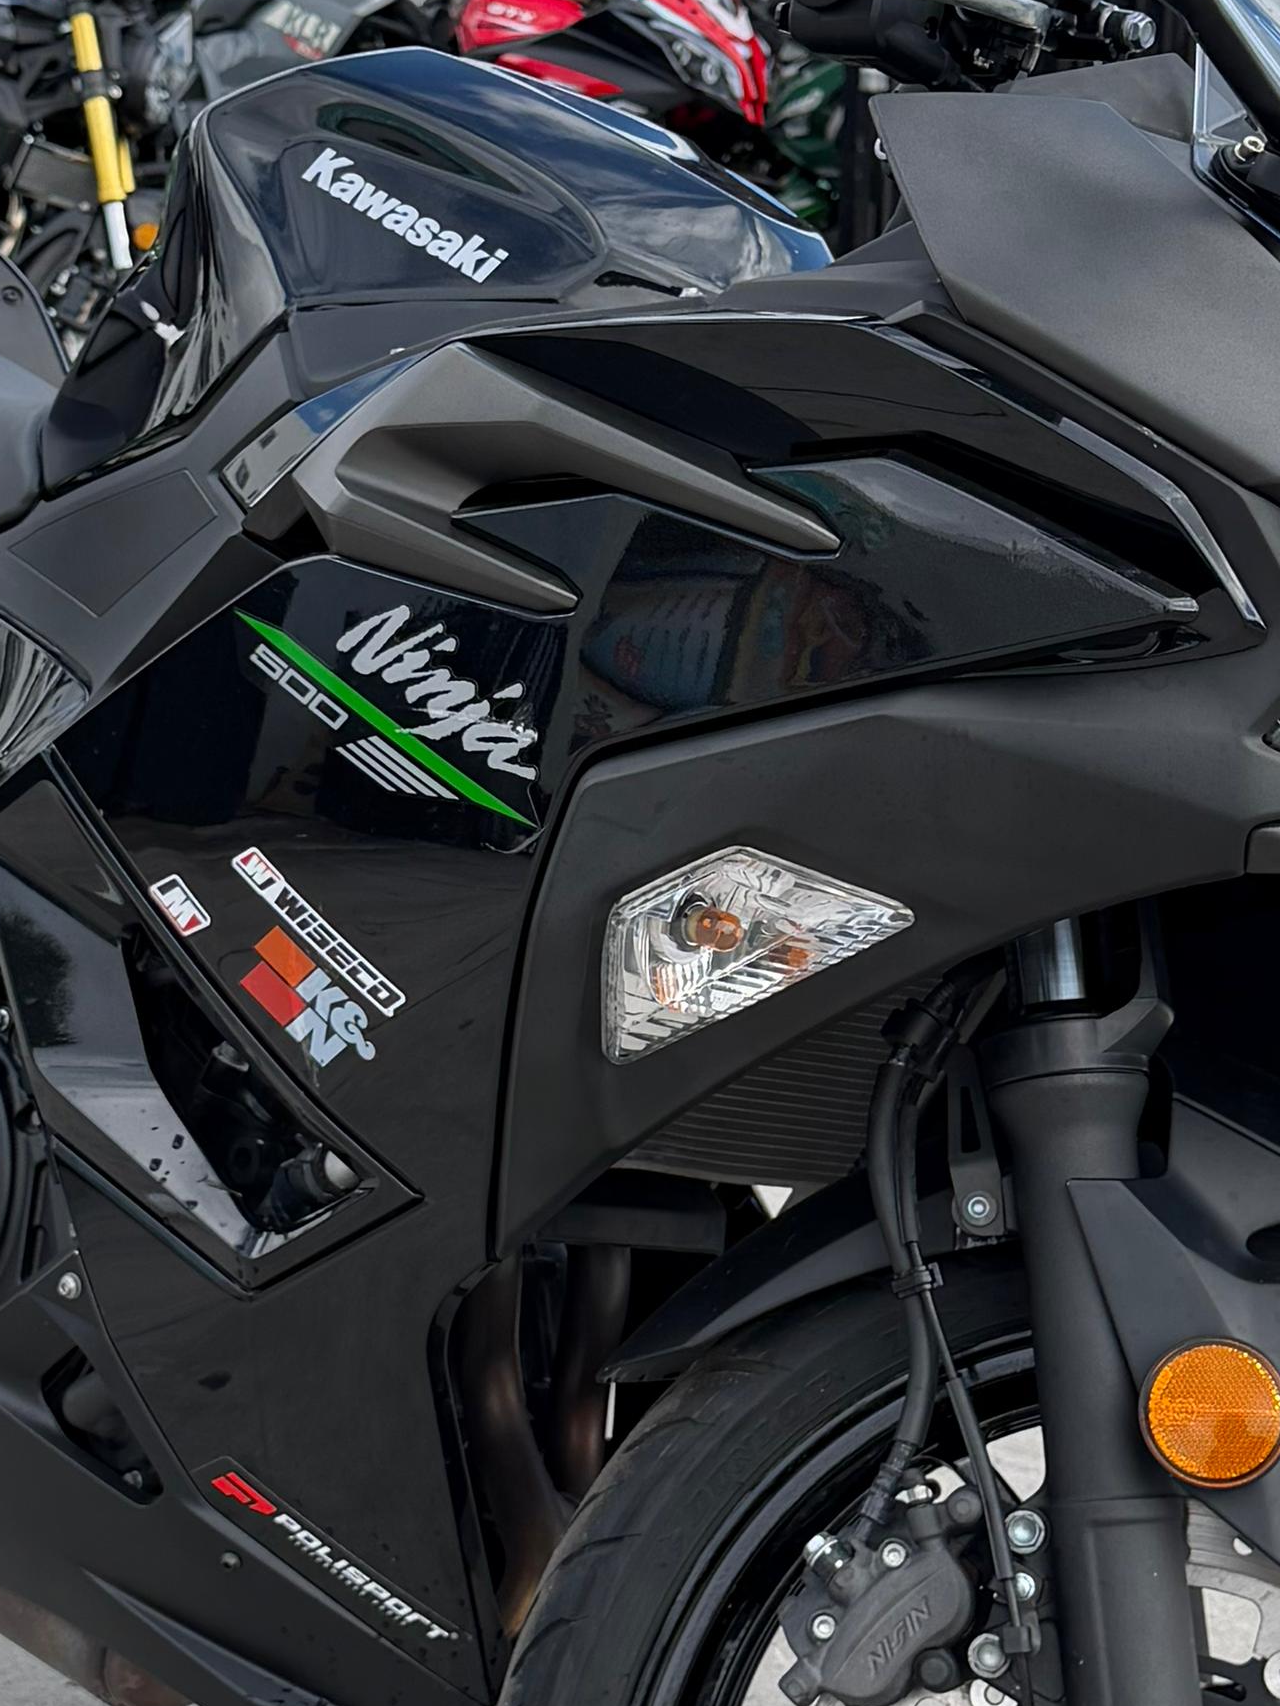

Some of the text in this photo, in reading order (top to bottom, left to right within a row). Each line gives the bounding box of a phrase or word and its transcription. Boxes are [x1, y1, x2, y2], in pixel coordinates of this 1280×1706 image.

[301, 147, 509, 283] Kawasaki
[249, 643, 349, 731] 500
[335, 604, 539, 781] Ninja
